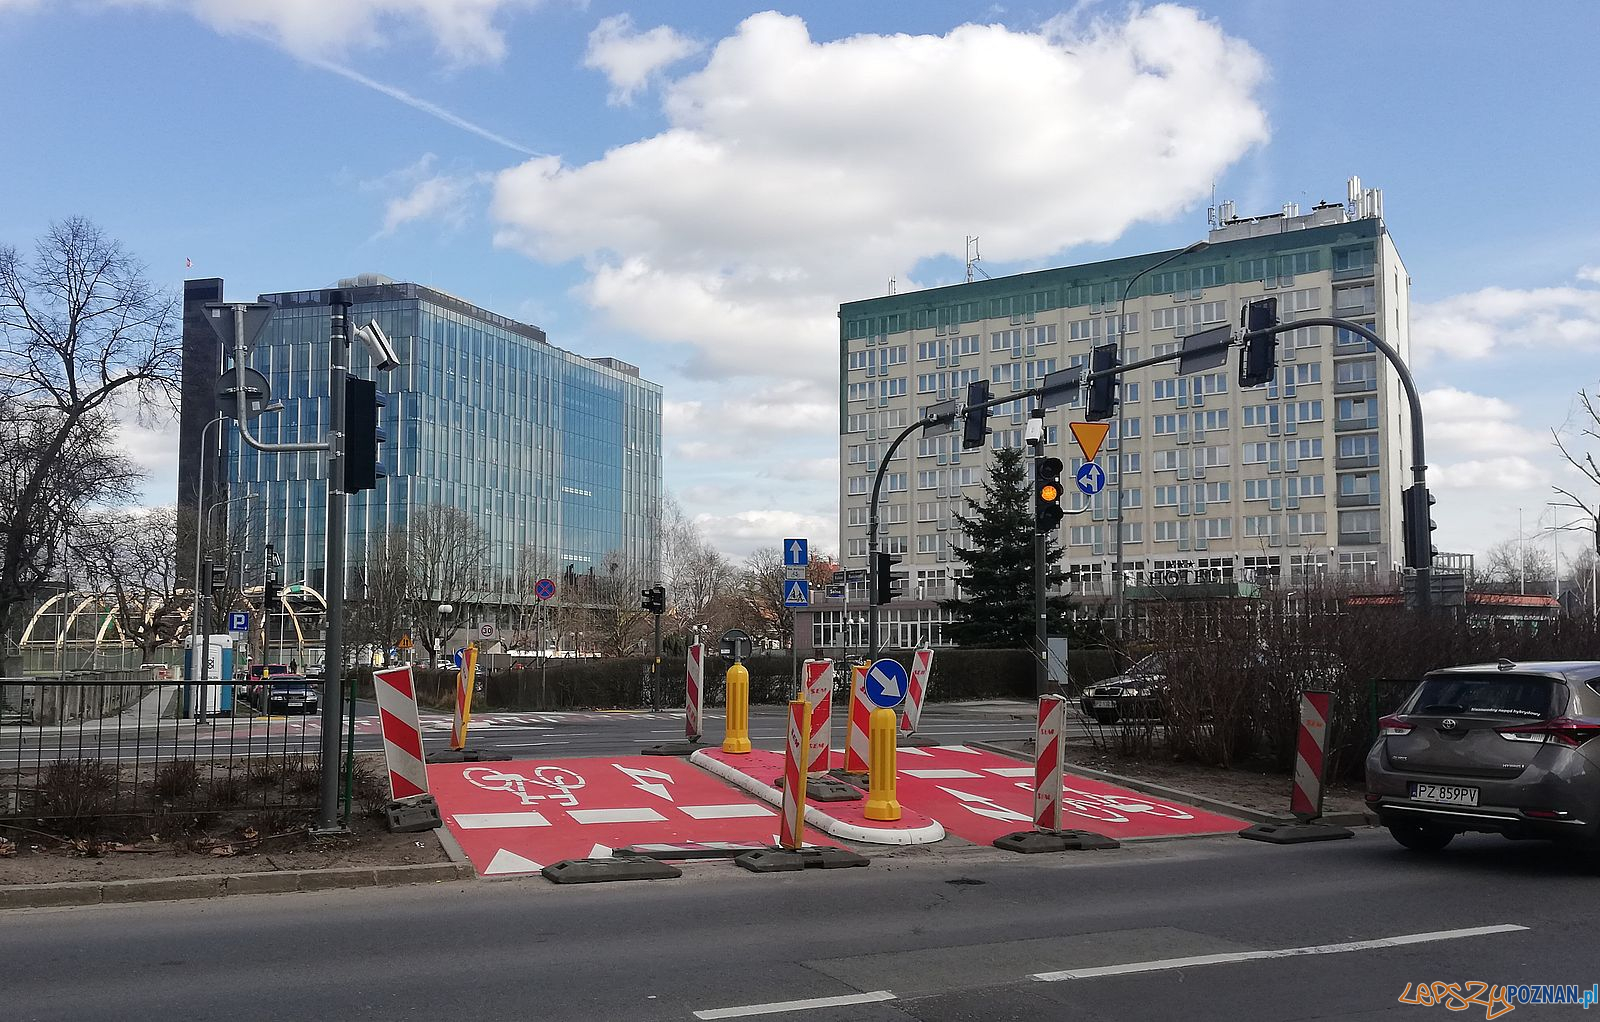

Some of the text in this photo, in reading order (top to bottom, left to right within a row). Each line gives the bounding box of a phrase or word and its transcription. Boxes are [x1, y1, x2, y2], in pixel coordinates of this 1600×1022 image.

[1148, 568, 1221, 585] HOTEL
[233, 614, 246, 628] P
[1418, 784, 1478, 803] PZ 859PV
